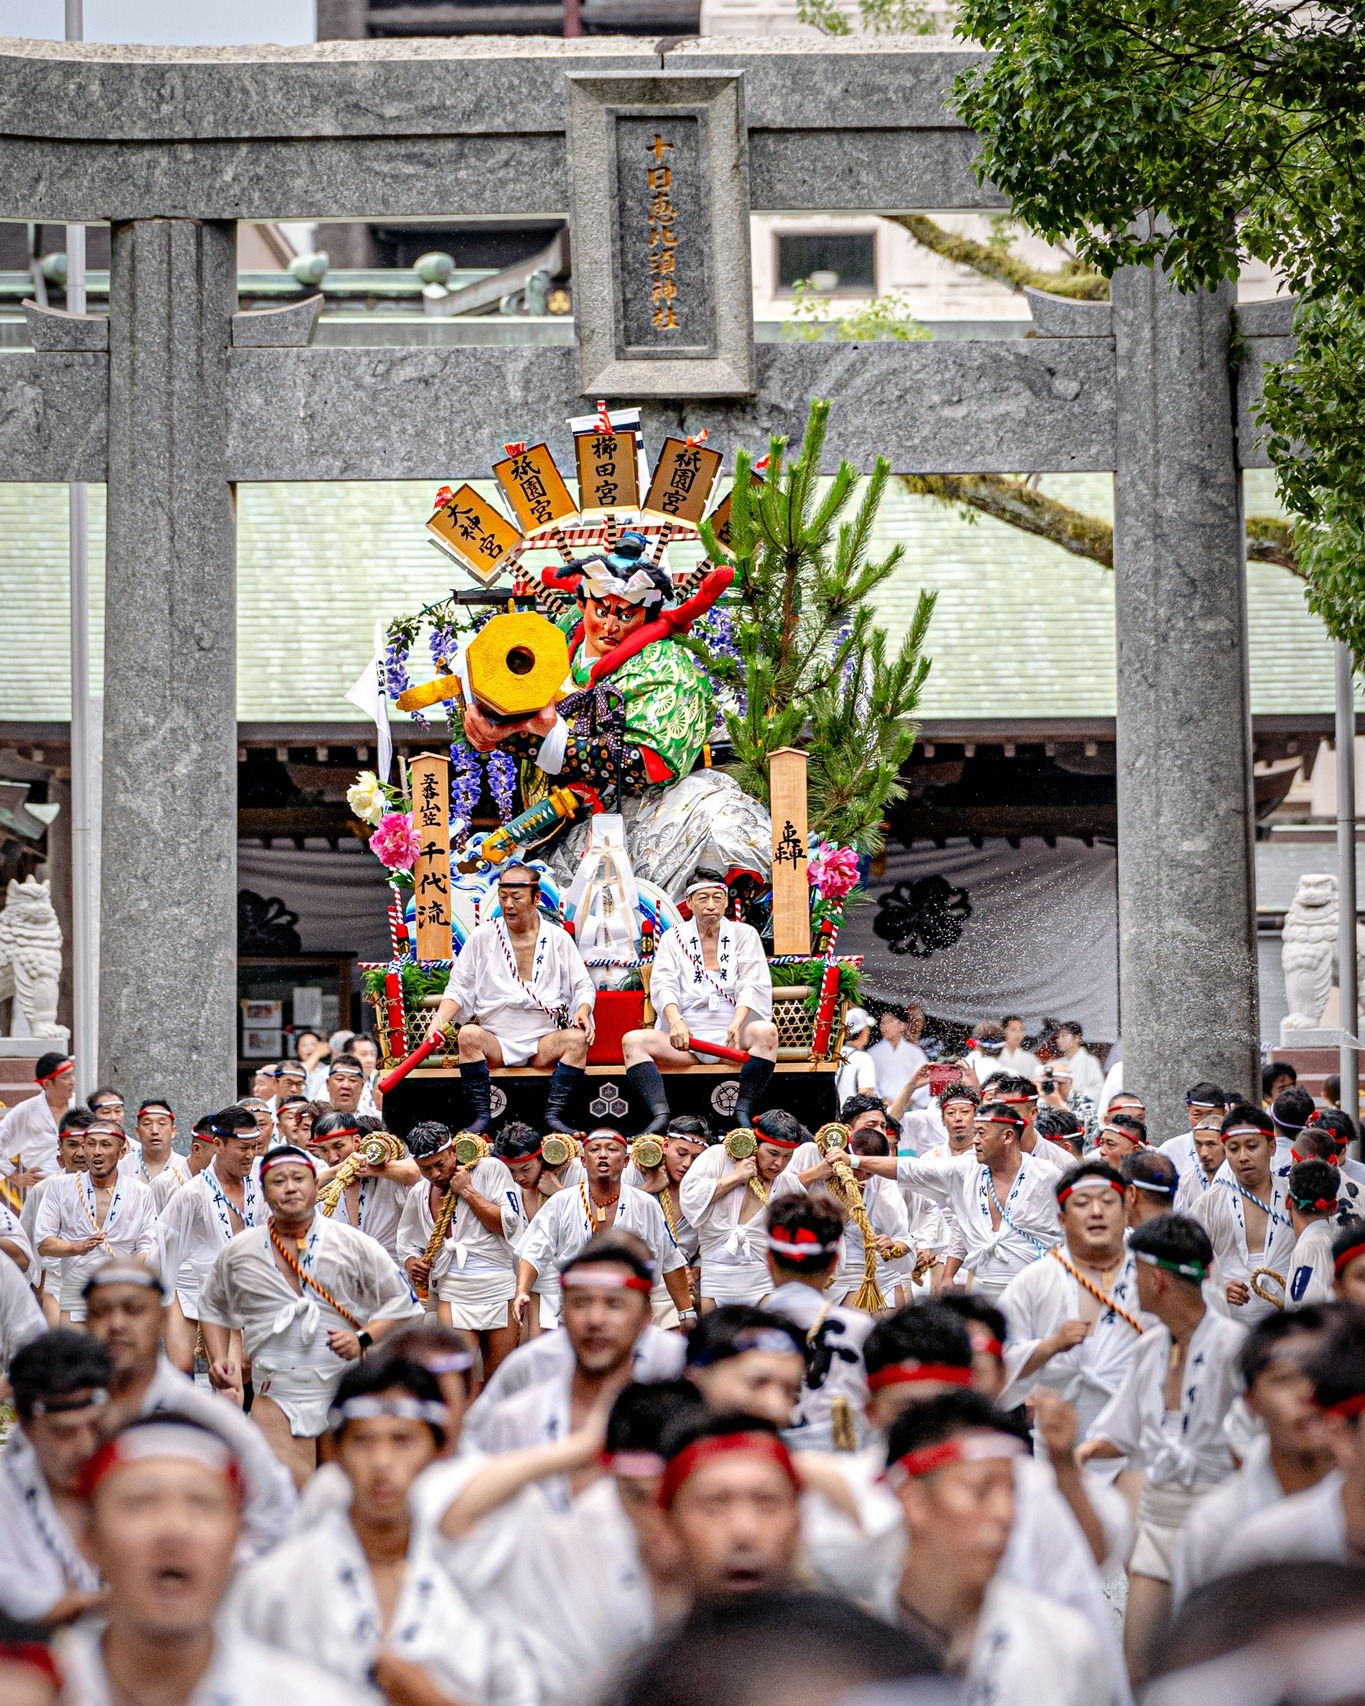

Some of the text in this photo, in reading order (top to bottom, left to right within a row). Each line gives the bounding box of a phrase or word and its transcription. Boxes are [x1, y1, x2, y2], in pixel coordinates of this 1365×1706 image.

[592, 436, 618, 506] 櫛田宮
[446, 503, 503, 559] 大神宮
[417, 773, 450, 929] 五番山笠 千代流
[773, 820, 807, 870] 轟
